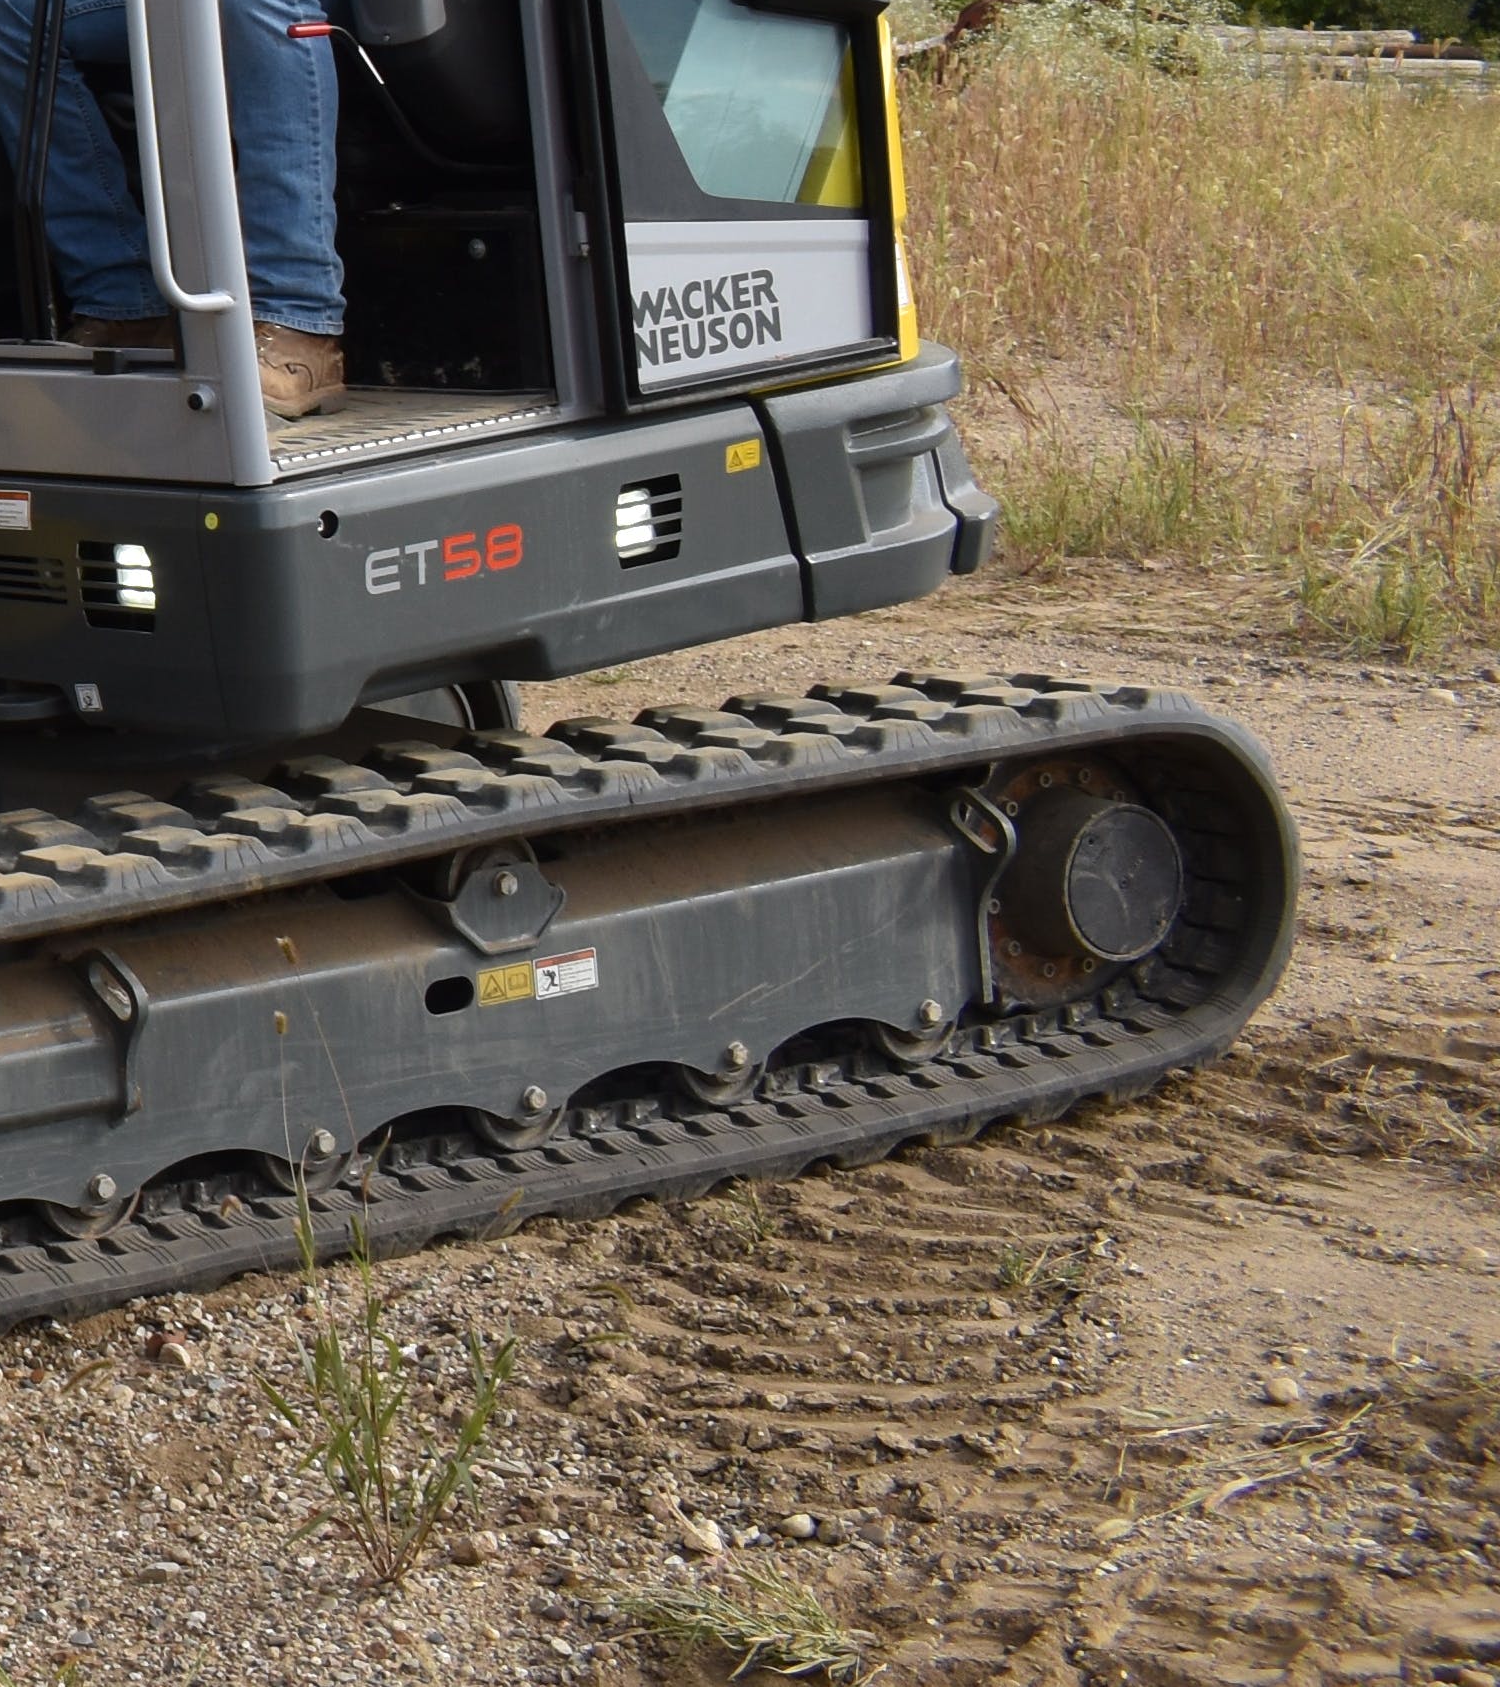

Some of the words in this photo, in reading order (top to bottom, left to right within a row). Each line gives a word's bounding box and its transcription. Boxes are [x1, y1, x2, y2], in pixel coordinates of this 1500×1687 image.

[631, 269, 779, 329] WACKER
[634, 306, 782, 369] NEUSON
[365, 523, 524, 595] ET58
